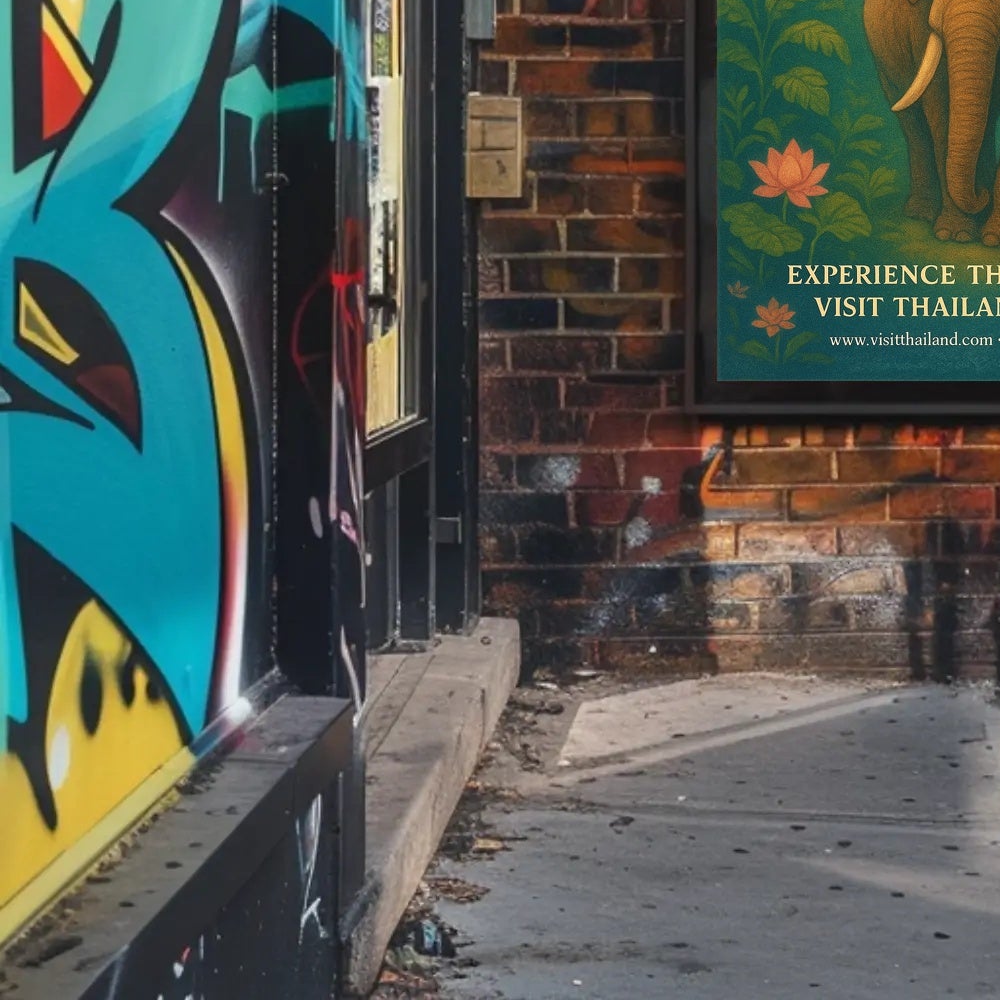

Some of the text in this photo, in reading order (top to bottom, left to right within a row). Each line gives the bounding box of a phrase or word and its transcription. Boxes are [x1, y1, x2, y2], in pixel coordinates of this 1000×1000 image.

[786, 264, 956, 285] EXPERIENCE
[813, 296, 885, 318] VISIT
[829, 331, 993, 347] www.visitthailand.com
